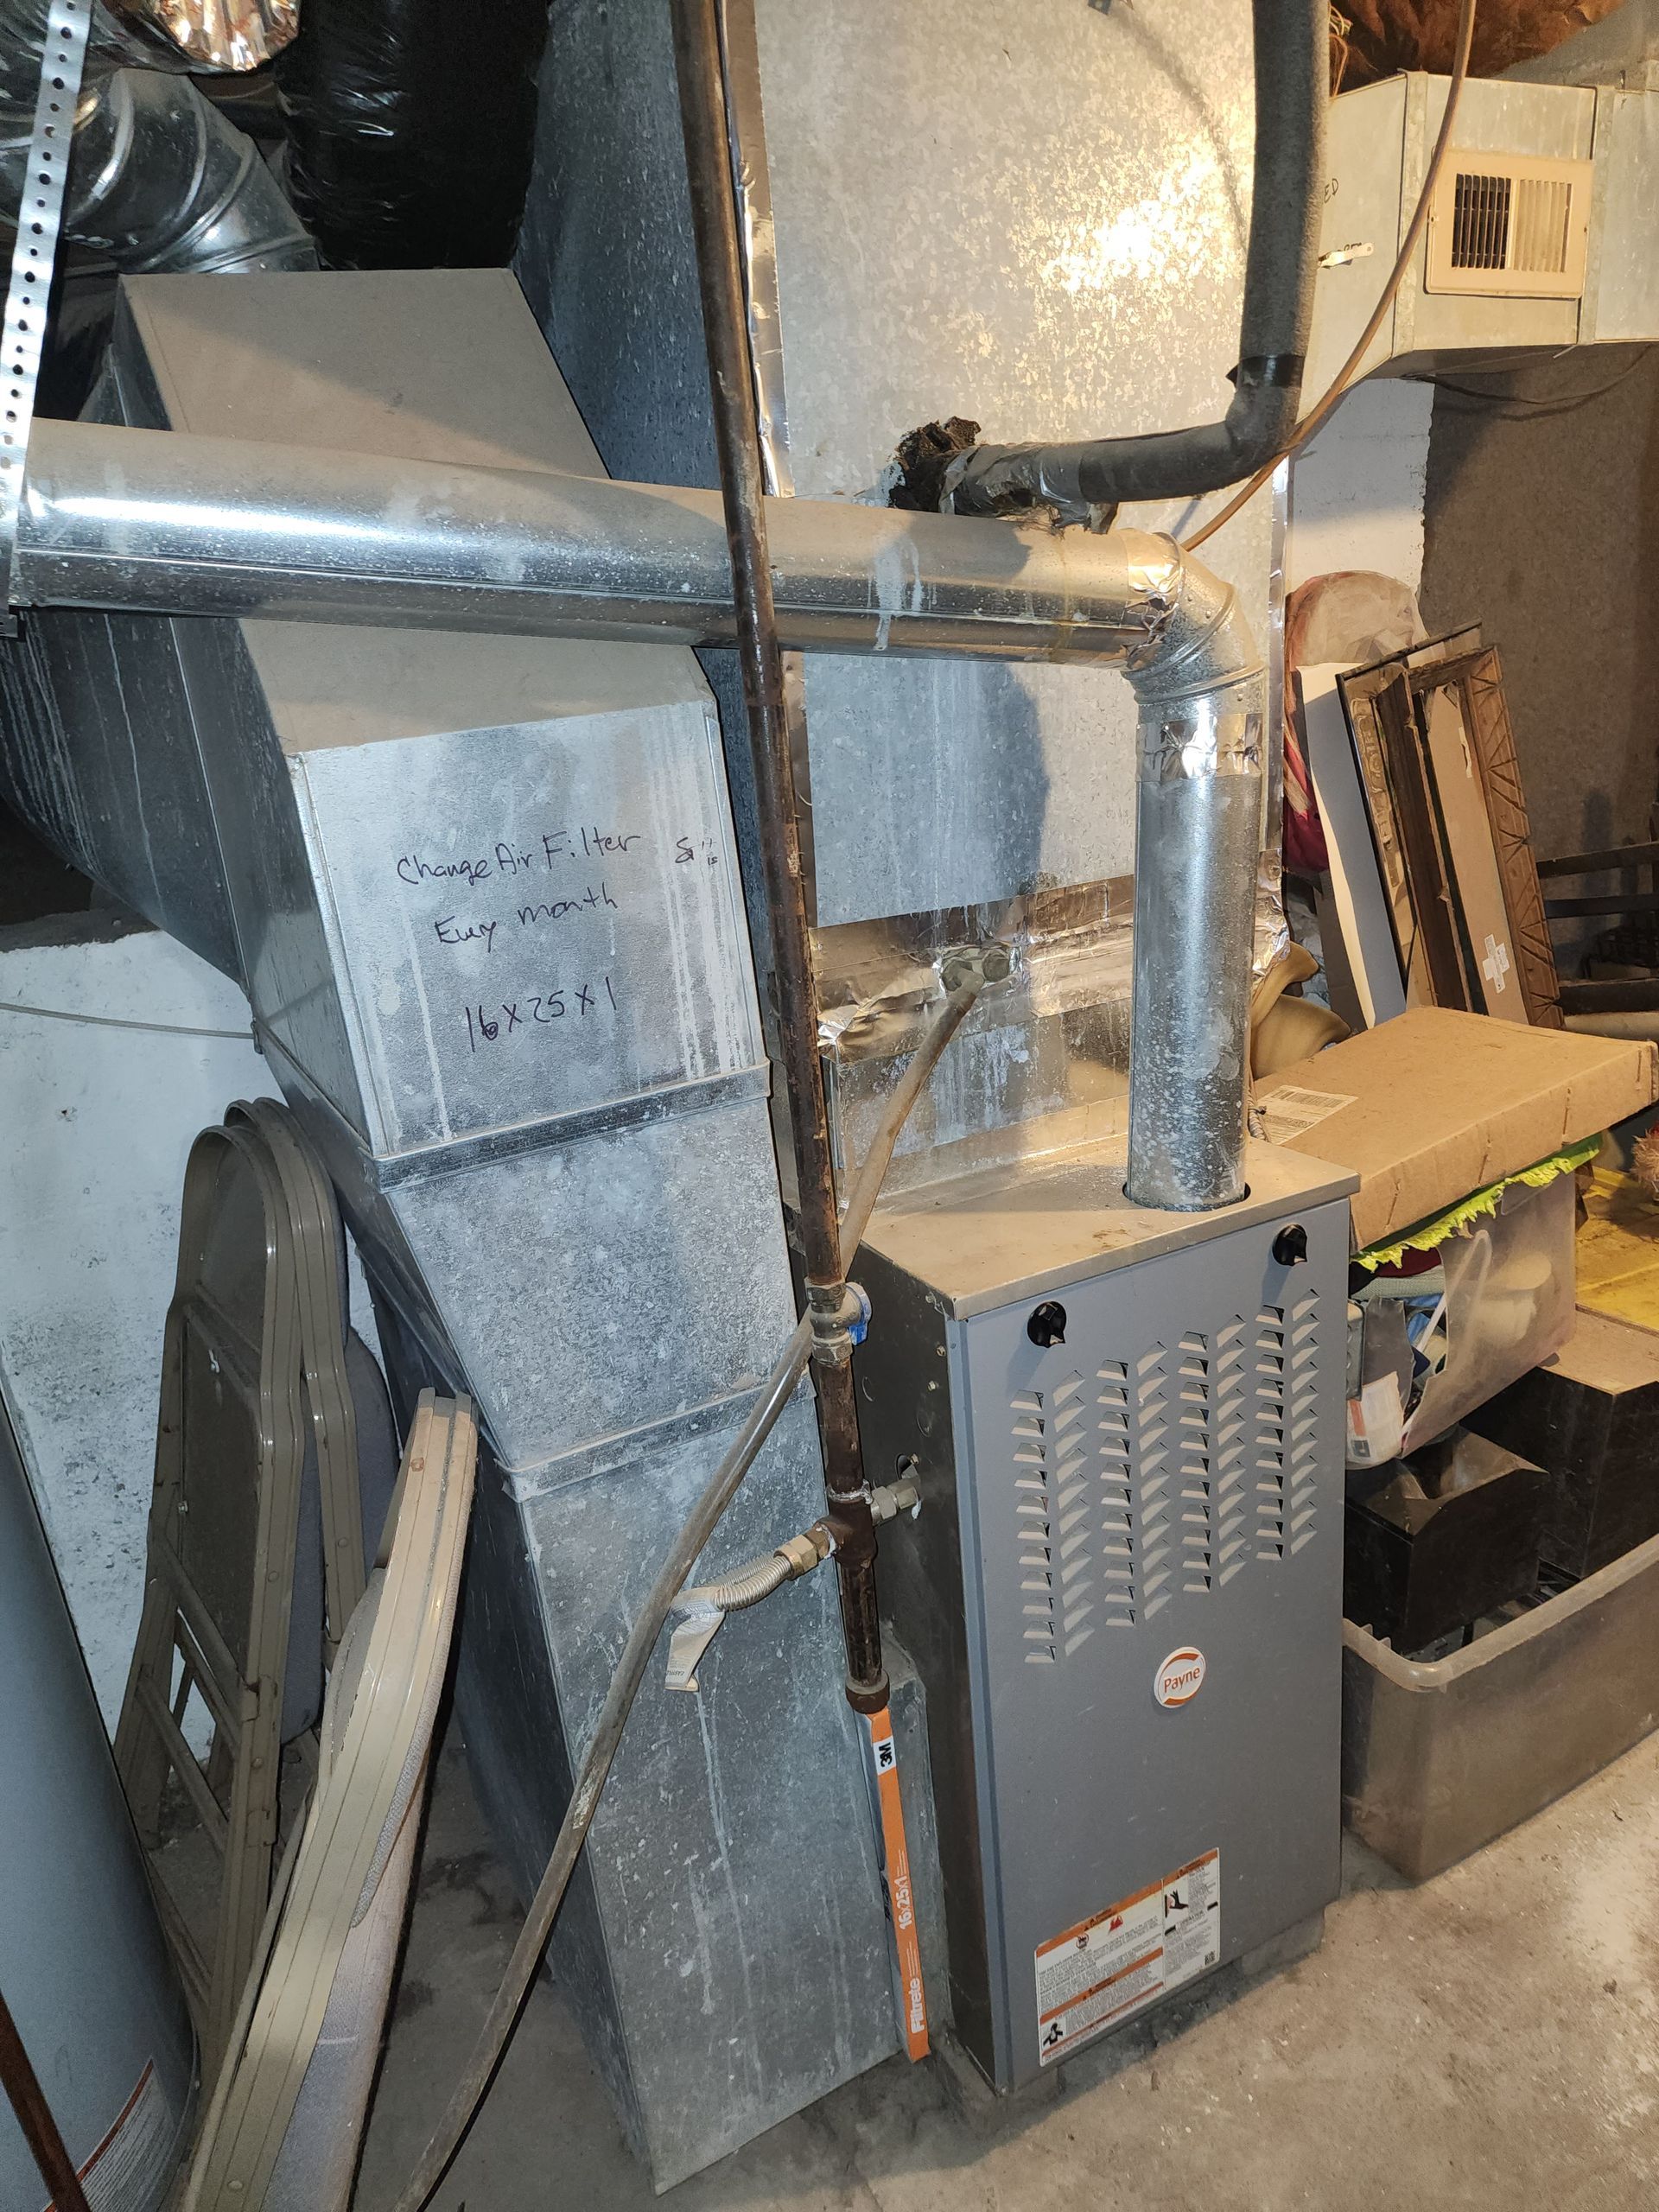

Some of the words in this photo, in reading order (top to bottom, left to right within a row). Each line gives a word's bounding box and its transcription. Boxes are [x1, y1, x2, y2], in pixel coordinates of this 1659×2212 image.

[495, 842, 533, 875] Air
[542, 826, 641, 870] Filter
[518, 881, 619, 925] month
[1163, 1667, 1201, 1694] Payne
[878, 1741, 893, 1768] 3M
[893, 1874, 912, 1930] 16x25x1
[908, 1976, 926, 2034] Filtrete
